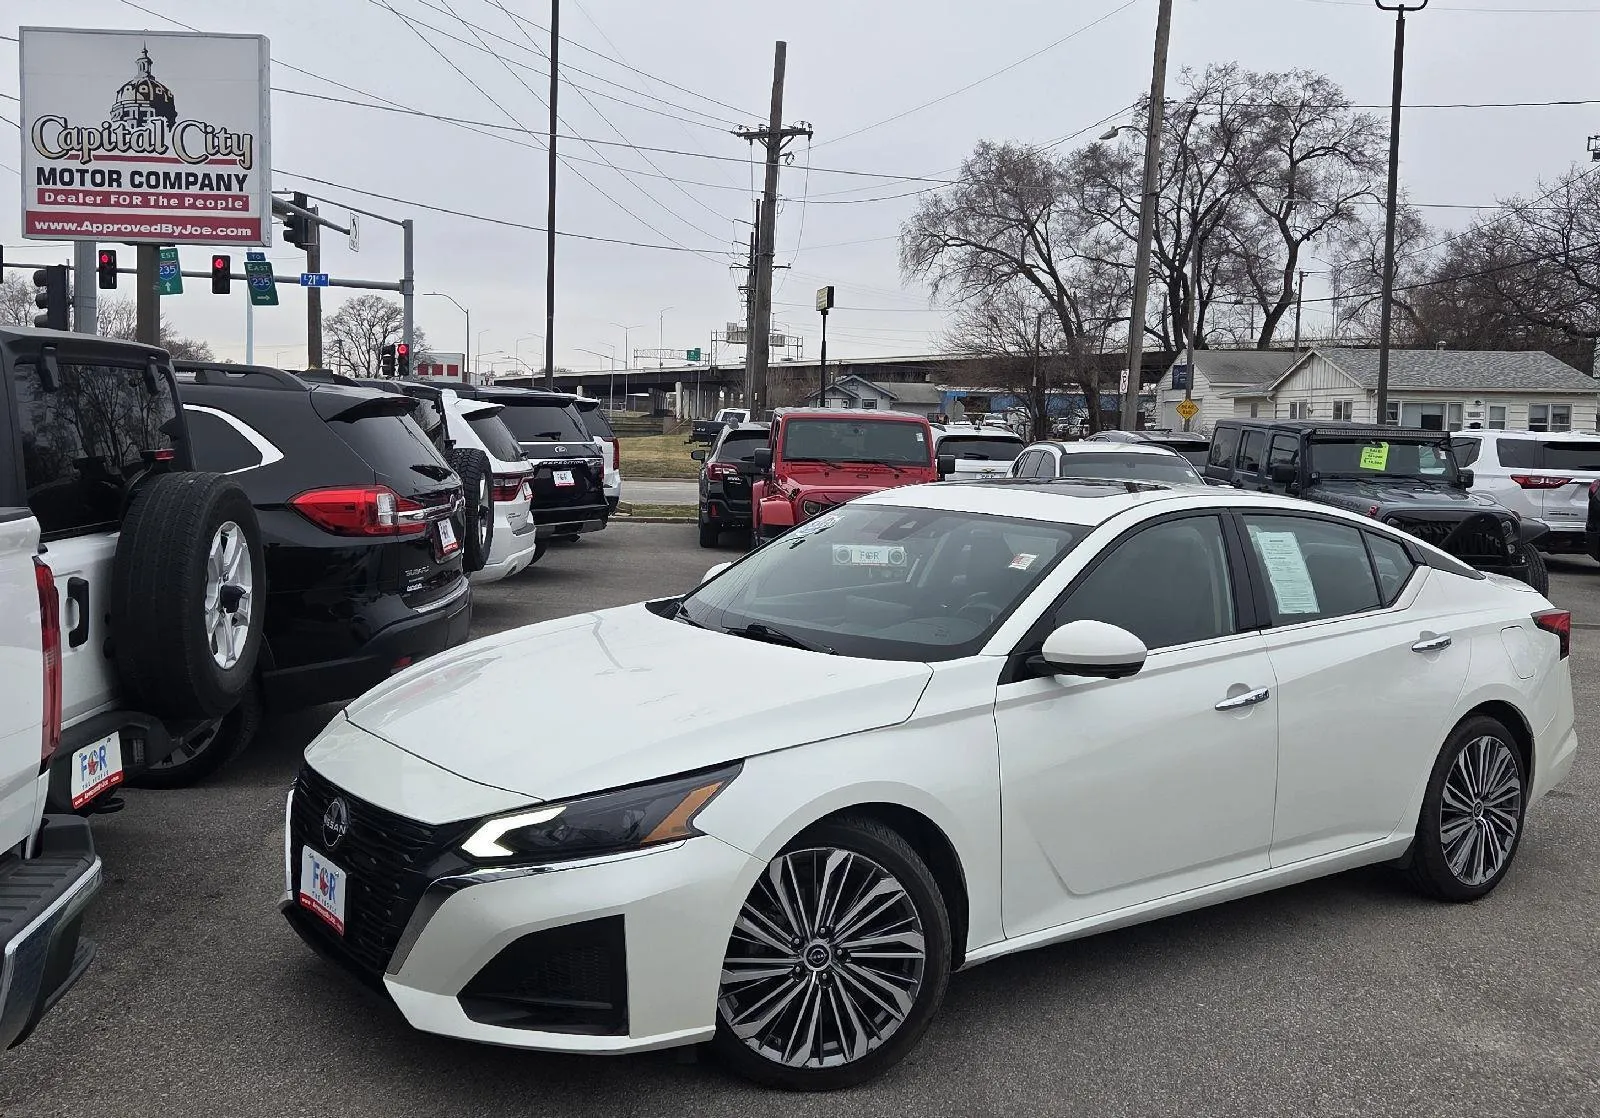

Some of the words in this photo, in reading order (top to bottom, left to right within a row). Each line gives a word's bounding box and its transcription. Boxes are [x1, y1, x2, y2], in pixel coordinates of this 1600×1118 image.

[32, 114, 169, 165] Capital
[172, 119, 253, 170] City
[36, 166, 122, 188] MOTOR
[130, 170, 248, 192] COMPANY
[44, 191, 103, 203] Dealer
[110, 194, 142, 205] FOR
[148, 196, 179, 206] The
[184, 197, 243, 209] People
[35, 220, 252, 236] www.ApprovedByJoe.com
[160, 251, 175, 259] EST
[160, 265, 176, 275] 235
[252, 277, 270, 286] 235
